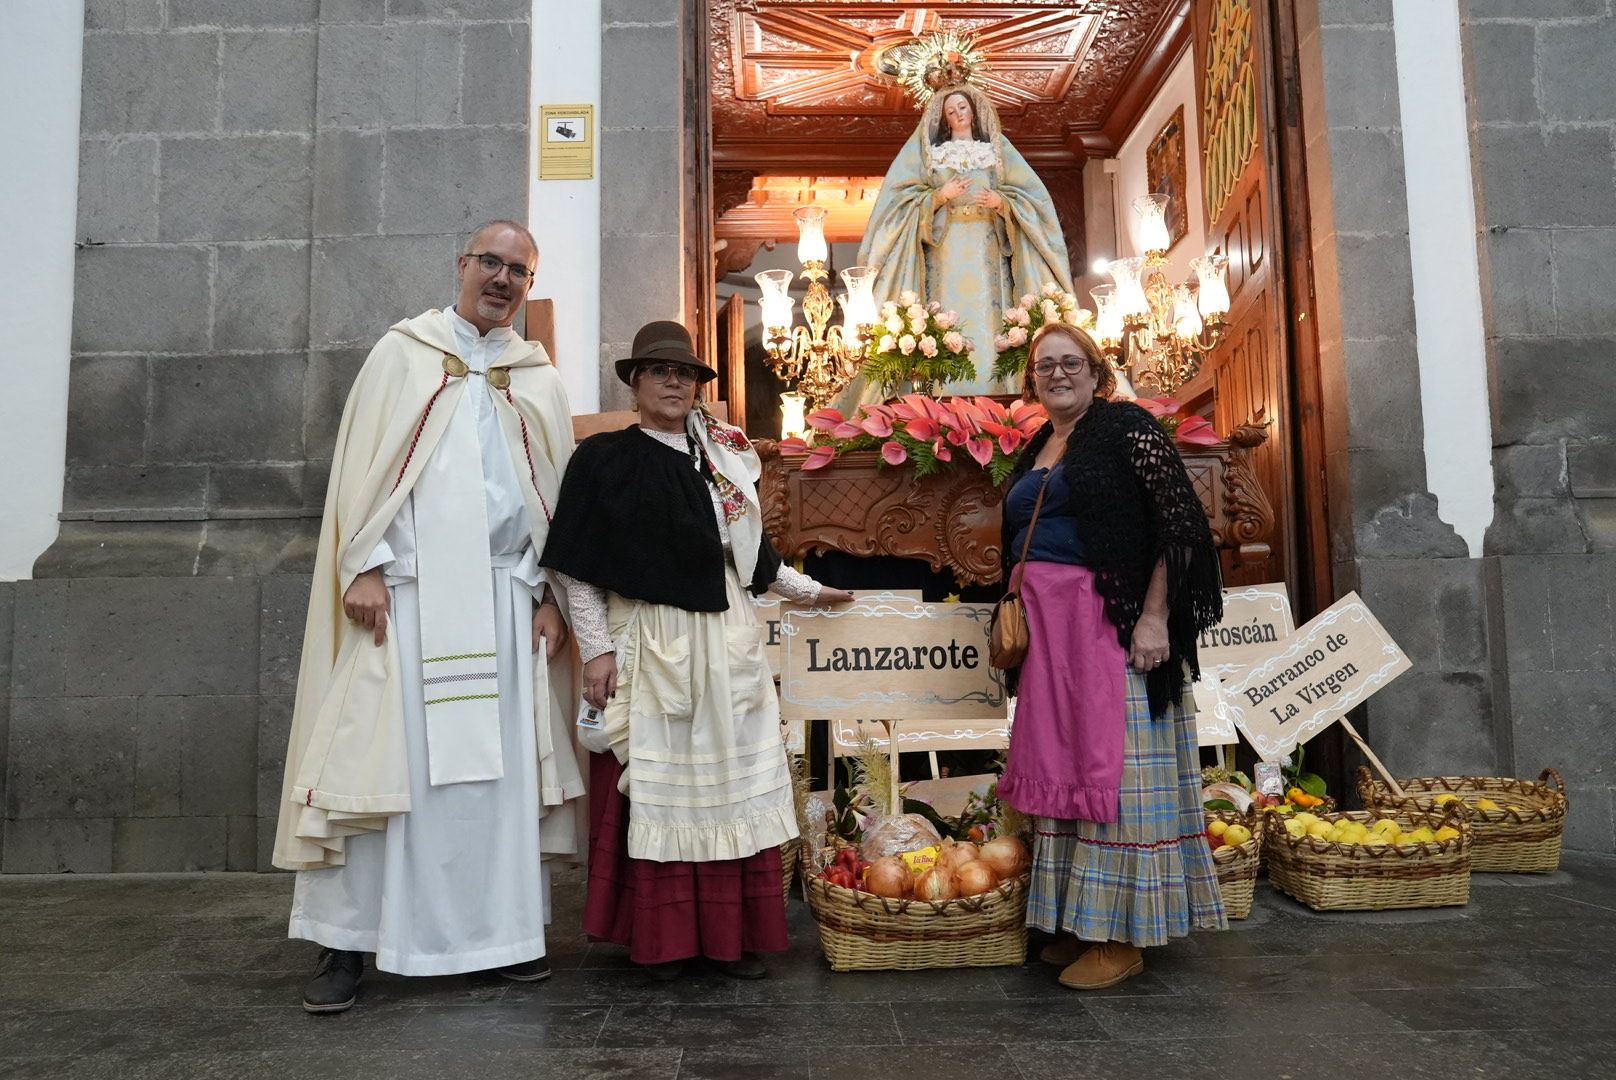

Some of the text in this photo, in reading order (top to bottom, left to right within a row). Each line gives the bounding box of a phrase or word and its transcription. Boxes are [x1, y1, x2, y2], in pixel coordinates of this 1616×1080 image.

[1200, 617, 1278, 648] rroscán
[806, 638, 979, 672] Lanzarote
[1243, 632, 1348, 707] Barranco de
[1270, 704, 1300, 725] La
